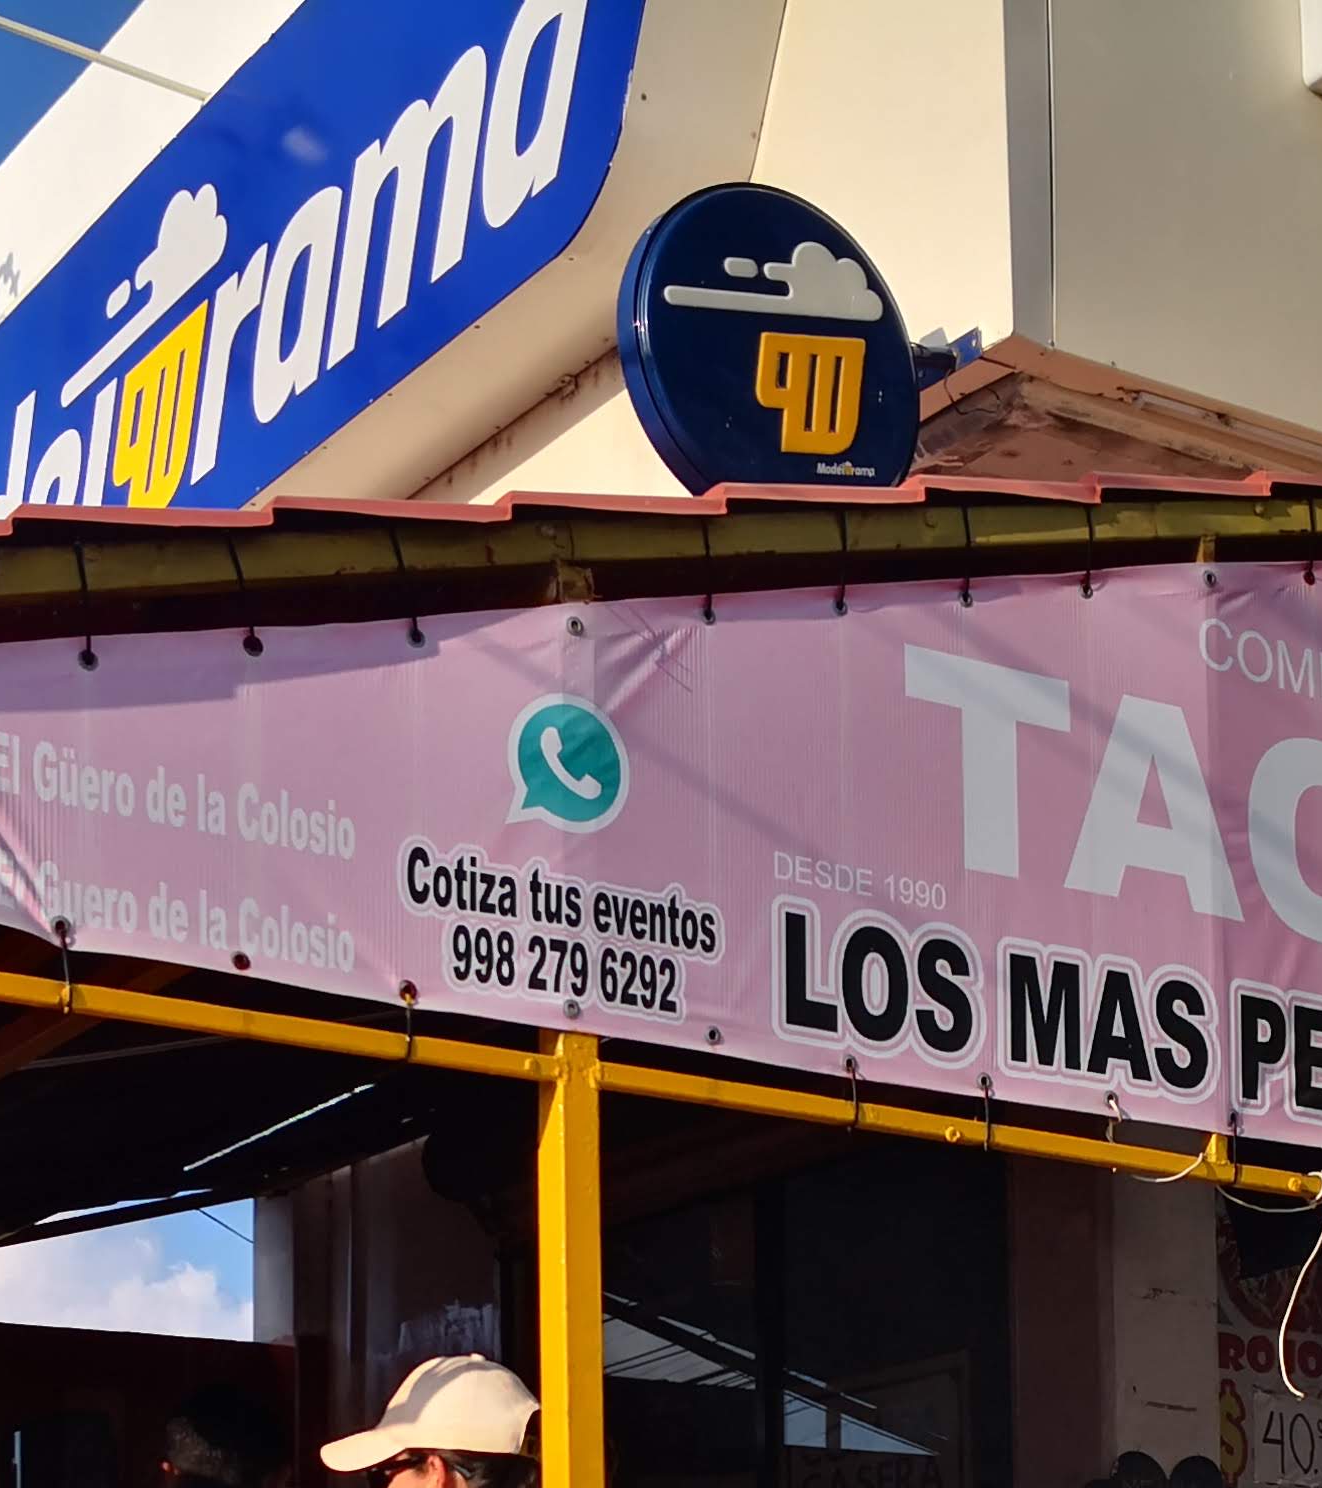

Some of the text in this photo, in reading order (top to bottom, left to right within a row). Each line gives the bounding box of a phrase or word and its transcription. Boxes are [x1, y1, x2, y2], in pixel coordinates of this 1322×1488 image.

[32, 741, 136, 818] Güero
[146, 766, 188, 828] de
[197, 773, 228, 836] la
[237, 782, 356, 860] Colosio
[148, 880, 189, 941] de
[198, 888, 229, 950] la
[238, 897, 356, 974] Colosio
[407, 846, 717, 952] Cotiza tus eventos
[774, 850, 948, 912] DESDE 1990
[452, 924, 678, 1014] 998 279 6292
[784, 911, 974, 1053] LOS
[1009, 952, 1210, 1090] MAS
